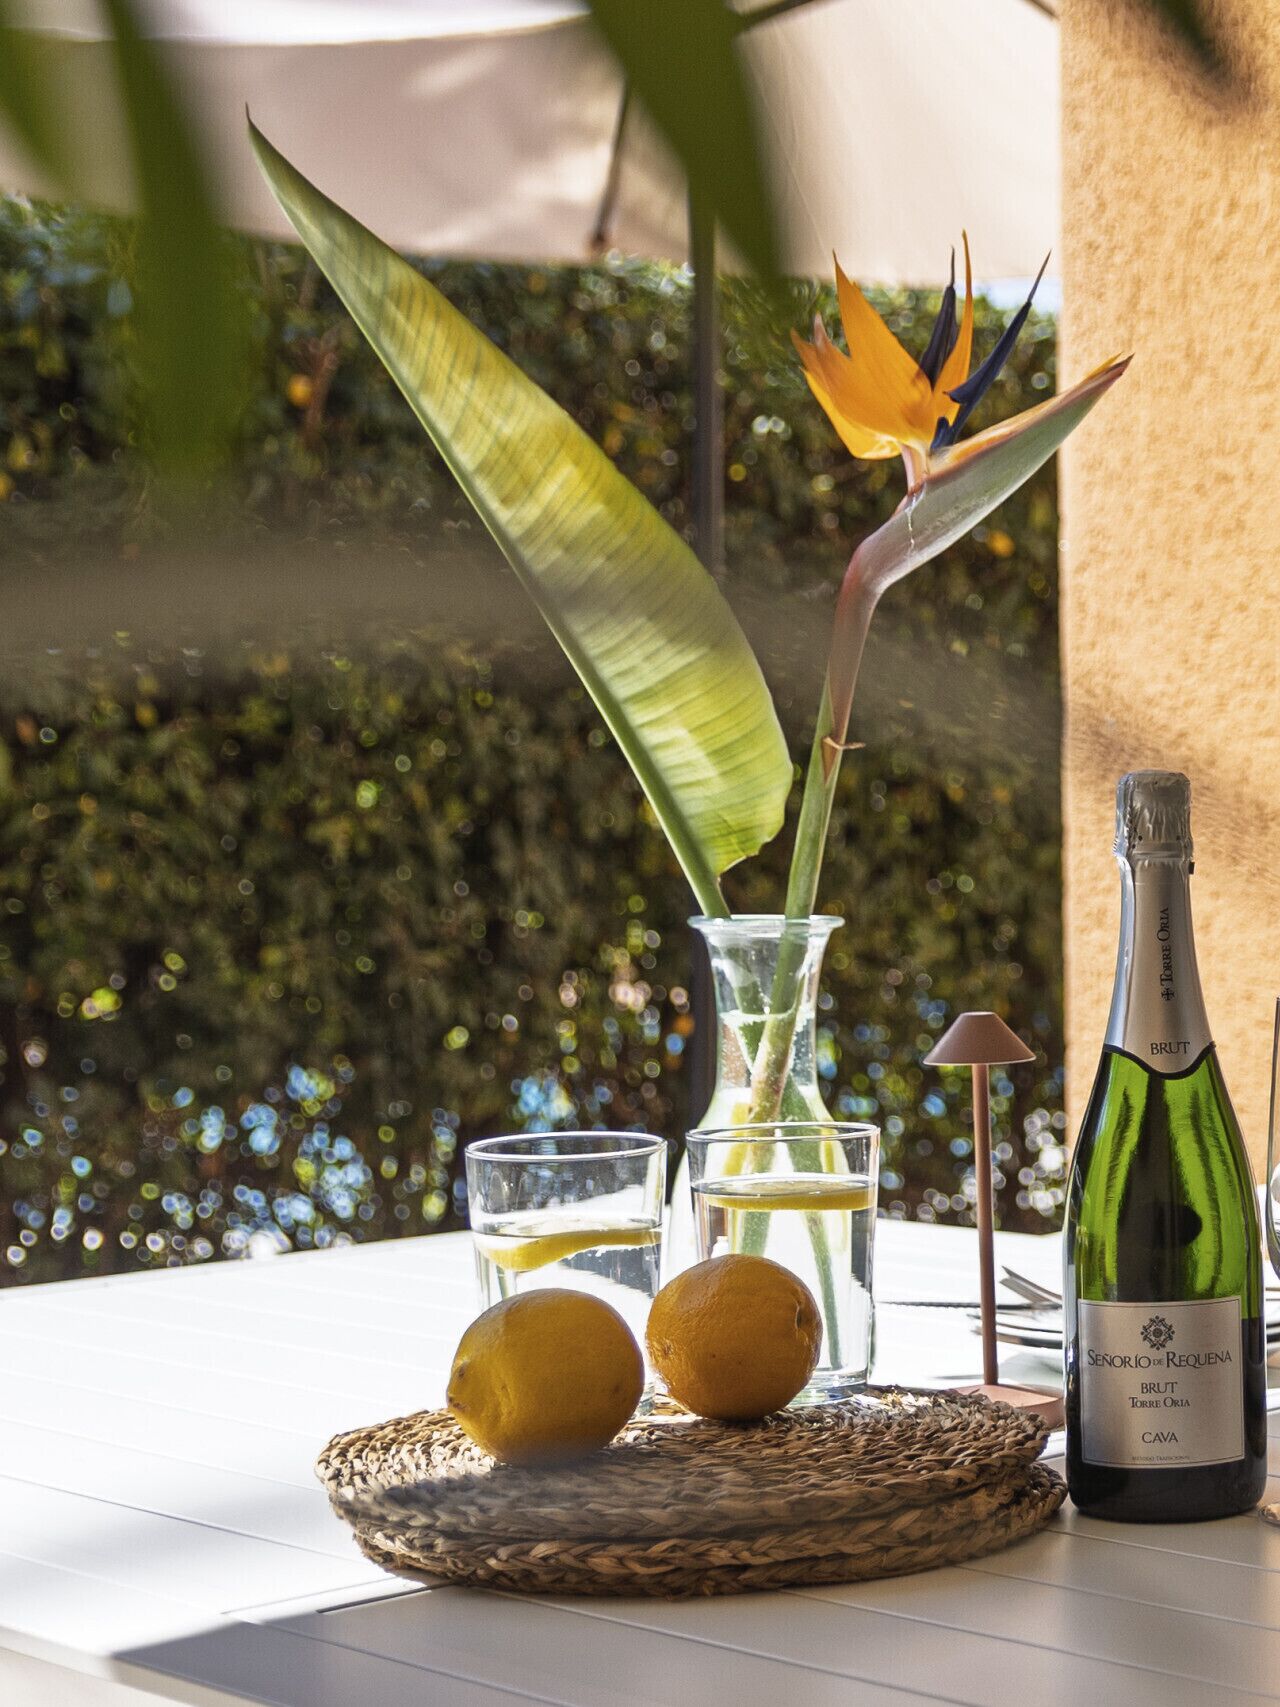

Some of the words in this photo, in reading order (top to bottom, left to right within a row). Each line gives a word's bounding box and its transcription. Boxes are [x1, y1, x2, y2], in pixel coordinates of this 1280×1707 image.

[1156, 907, 1170, 942] ORIA
[1160, 945, 1174, 986] TORRE
[1150, 1040, 1190, 1056] BRUT
[1087, 1349, 1151, 1369] SEÑORÍO
[1152, 1358, 1164, 1367] DE
[1166, 1350, 1233, 1369] REQUENA
[1140, 1381, 1178, 1394] BRUT
[1129, 1396, 1161, 1409] TORRE
[1163, 1396, 1191, 1408] ORIA
[1141, 1431, 1179, 1444] CAVA
